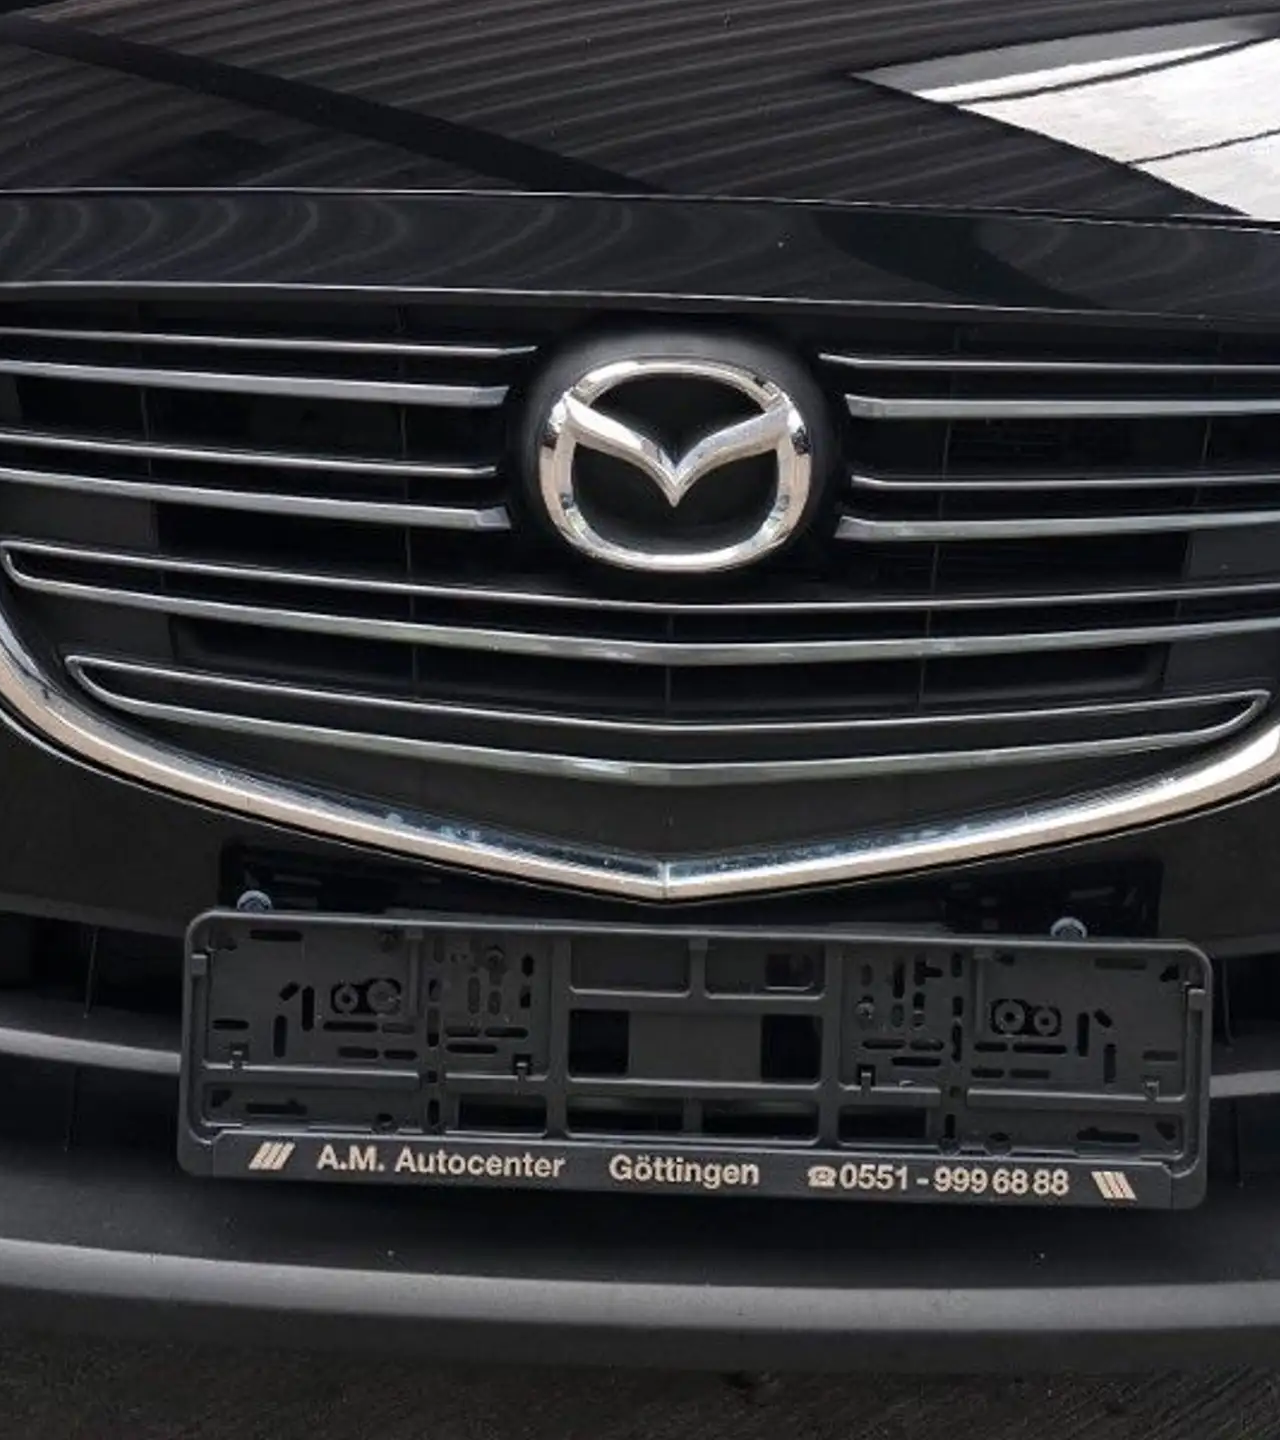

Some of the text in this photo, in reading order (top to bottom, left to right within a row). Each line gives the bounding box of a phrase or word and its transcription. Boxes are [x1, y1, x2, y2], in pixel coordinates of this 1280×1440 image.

[316, 1144, 385, 1171] A.M.
[394, 1146, 566, 1177] Autocenter
[609, 1154, 760, 1190] Göttingen
